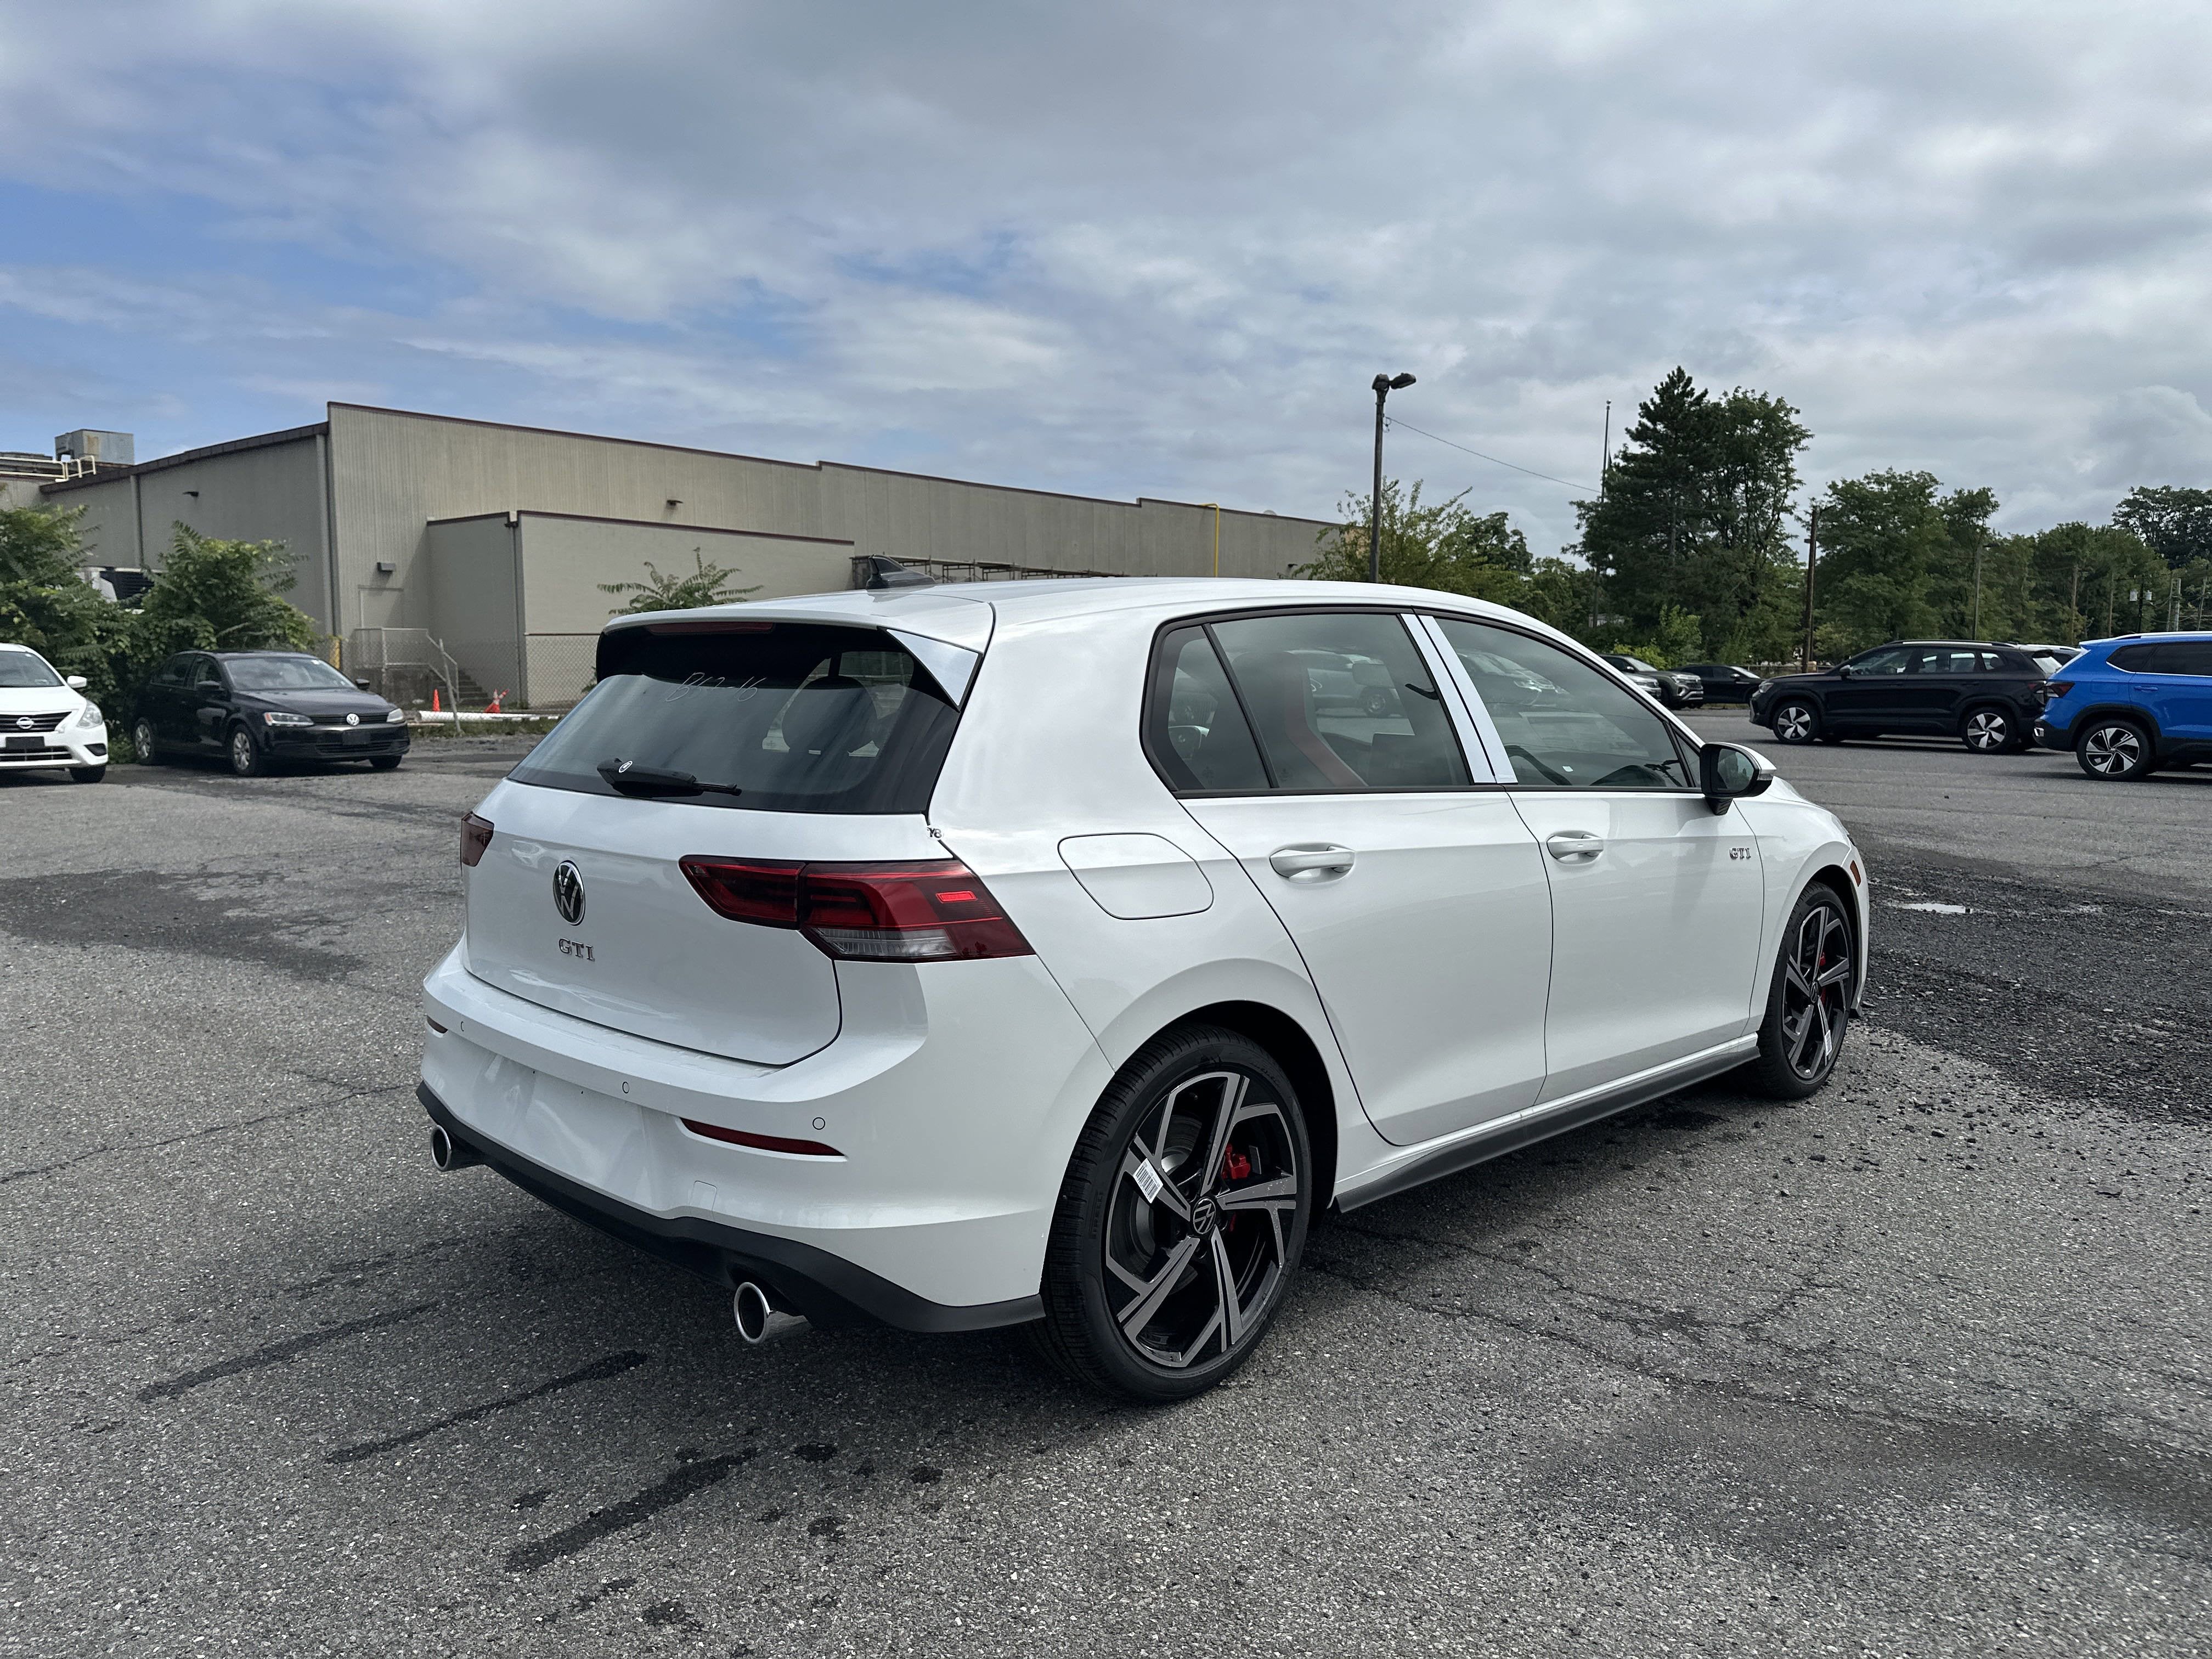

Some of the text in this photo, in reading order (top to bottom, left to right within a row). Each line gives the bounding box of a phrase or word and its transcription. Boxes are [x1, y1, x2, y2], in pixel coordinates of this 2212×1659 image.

[1729, 847, 1751, 860] GTI
[553, 860, 585, 926] VW
[558, 937, 595, 962] GTI
